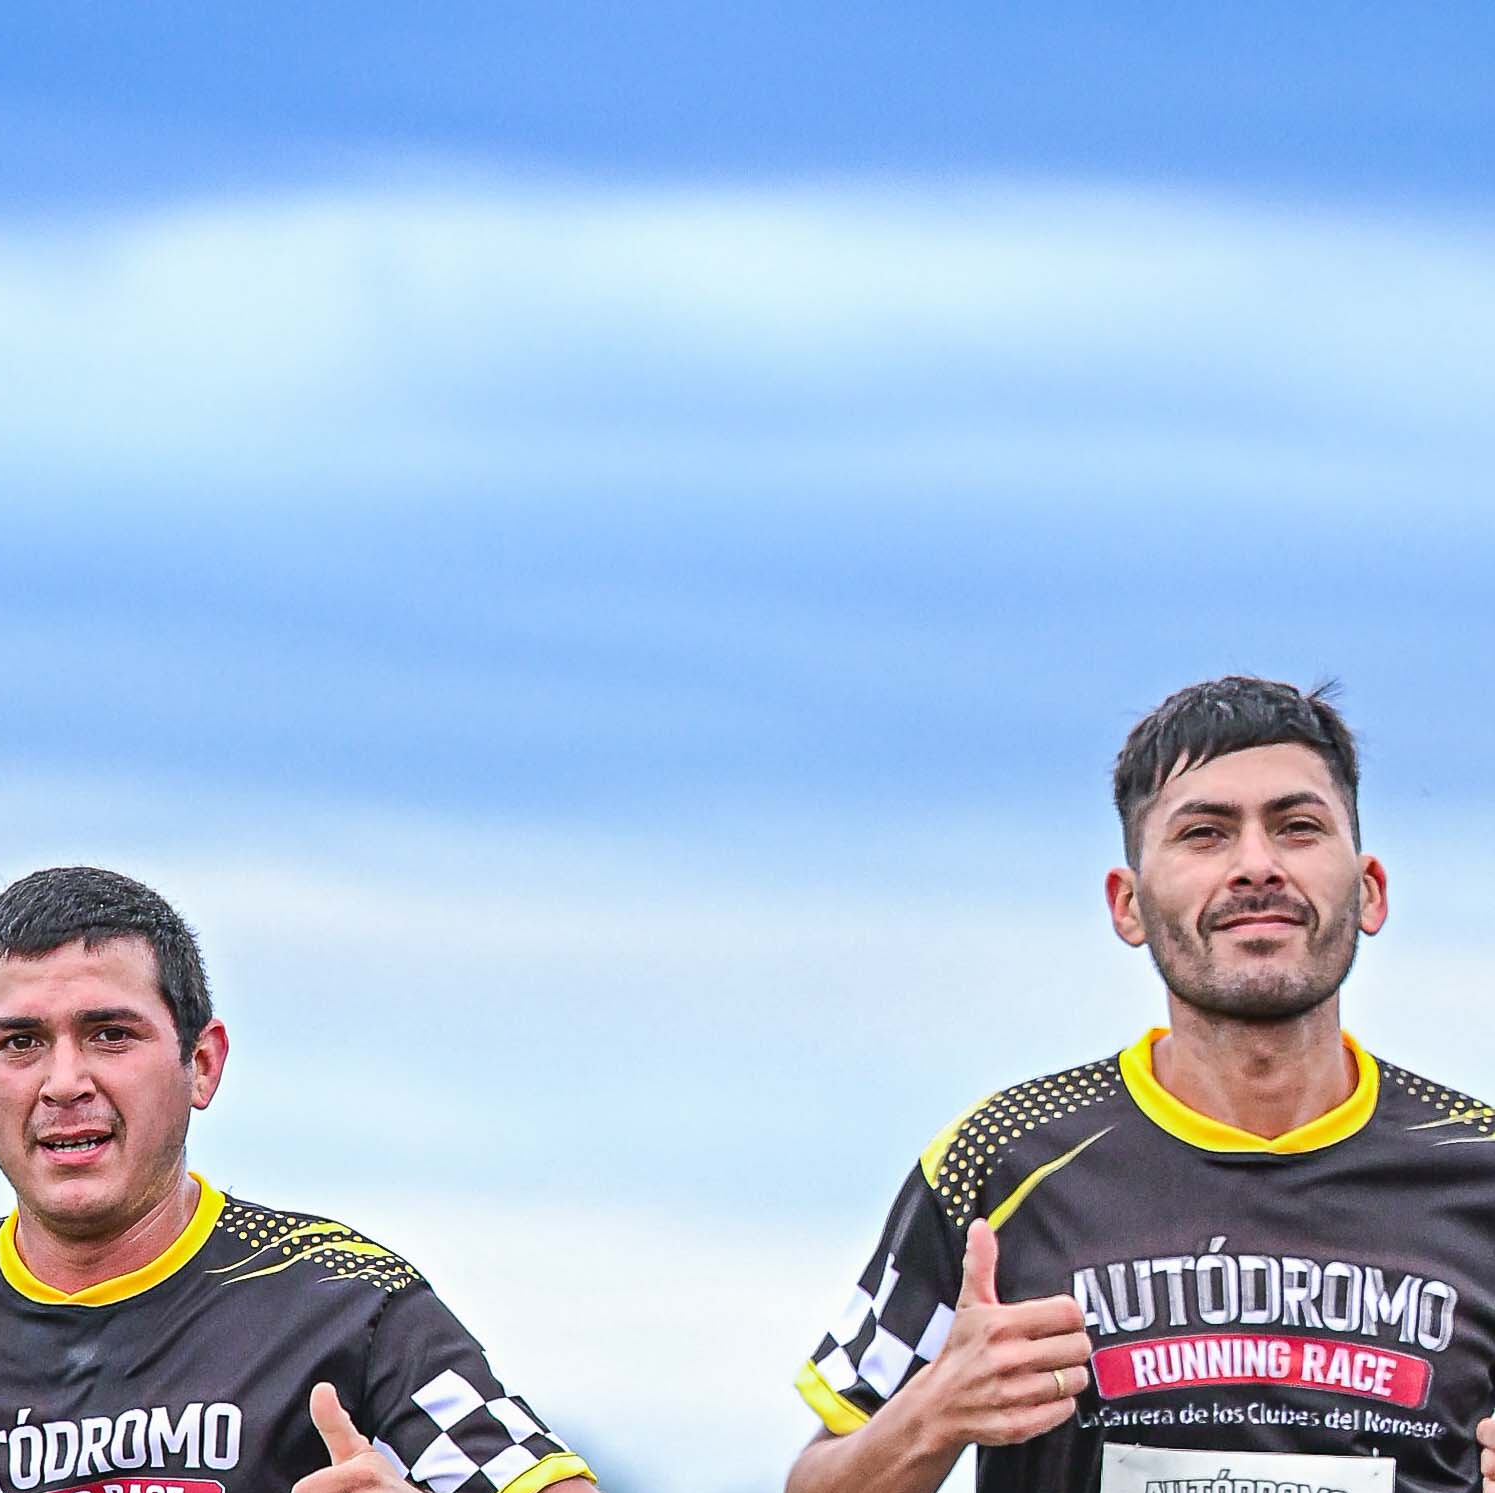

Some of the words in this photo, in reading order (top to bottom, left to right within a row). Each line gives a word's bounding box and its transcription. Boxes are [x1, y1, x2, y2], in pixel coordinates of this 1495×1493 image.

[1073, 1236, 1457, 1353] AUTÓDROMO
[1129, 1340, 1292, 1389] RUNNING
[1301, 1343, 1397, 1396] RACE
[1099, 1405, 1174, 1428] Carrera
[1179, 1402, 1208, 1424] de
[1213, 1402, 1245, 1424] los
[1247, 1402, 1321, 1427] Clubes
[1324, 1407, 1360, 1431] del
